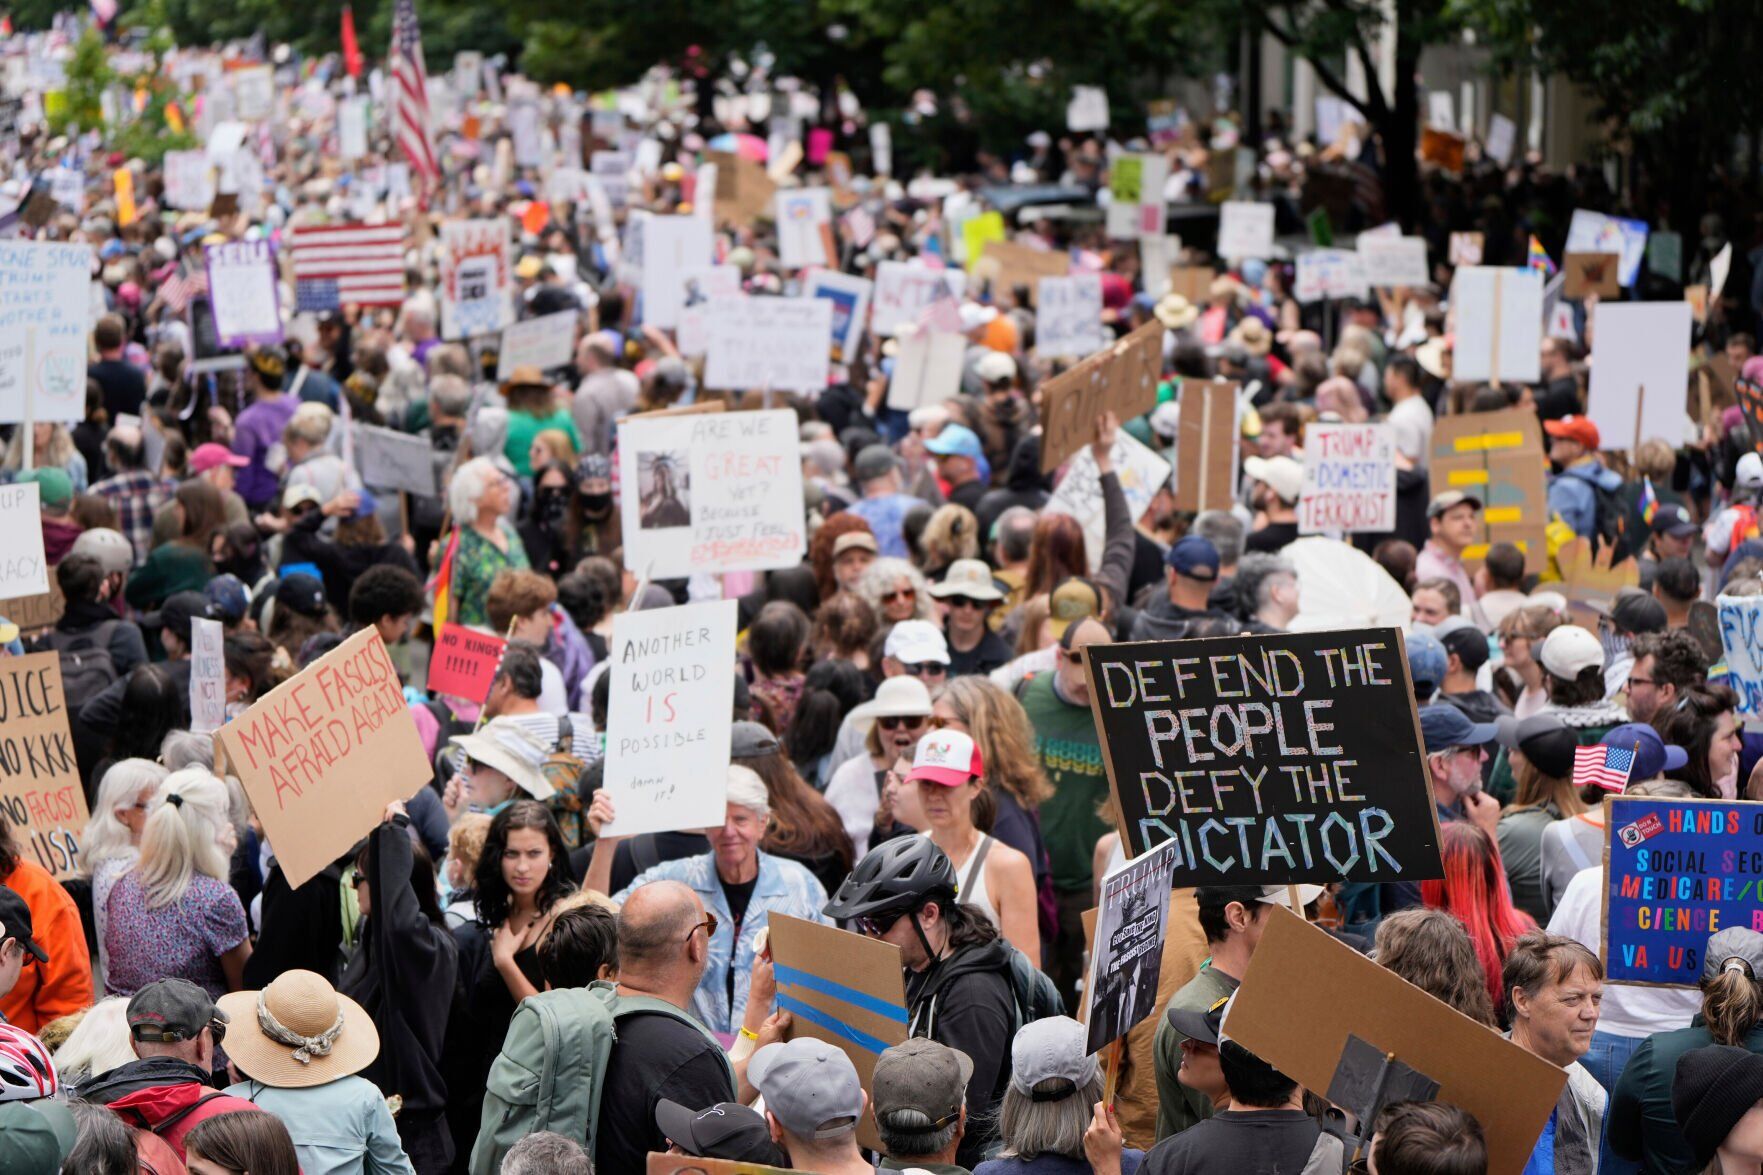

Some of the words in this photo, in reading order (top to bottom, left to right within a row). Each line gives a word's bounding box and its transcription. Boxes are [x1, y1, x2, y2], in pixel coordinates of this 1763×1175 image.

[0, 290, 54, 304] TARTS
[691, 418, 731, 441] ARE
[740, 416, 771, 436] WE
[1318, 428, 1374, 457] TRUMP
[705, 452, 783, 480] GREAT
[1318, 462, 1390, 489] DOMESTIC
[1303, 493, 1388, 527] TERRORIST
[442, 632, 457, 646] NO
[465, 639, 500, 657] KINGS
[622, 627, 711, 664] ANOTHER
[10, 665, 60, 718] ICE
[632, 664, 706, 692] WORLD
[1101, 645, 1305, 708] DEFEND
[1315, 643, 1392, 688] THE
[237, 683, 324, 770] MAKE
[316, 634, 393, 712] FASCIST
[646, 692, 677, 723] IS
[268, 719, 350, 810] AFRAID
[351, 682, 407, 744] AGAIN
[620, 729, 706, 757] POSSIBLE
[1144, 700, 1343, 768] PEOPLE
[23, 732, 77, 778] KKK
[1140, 765, 1268, 816] DEFY
[1279, 760, 1366, 803] THE
[25, 785, 80, 828] FACIST
[1669, 809, 1740, 834] HANDS
[31, 830, 81, 874] USA
[1139, 806, 1402, 875] DICTATOR
[1637, 849, 1707, 874] SOCIAL
[1107, 847, 1174, 910] TRUMP
[1623, 906, 1720, 932] SCIENCE
[1668, 946, 1697, 970] US
